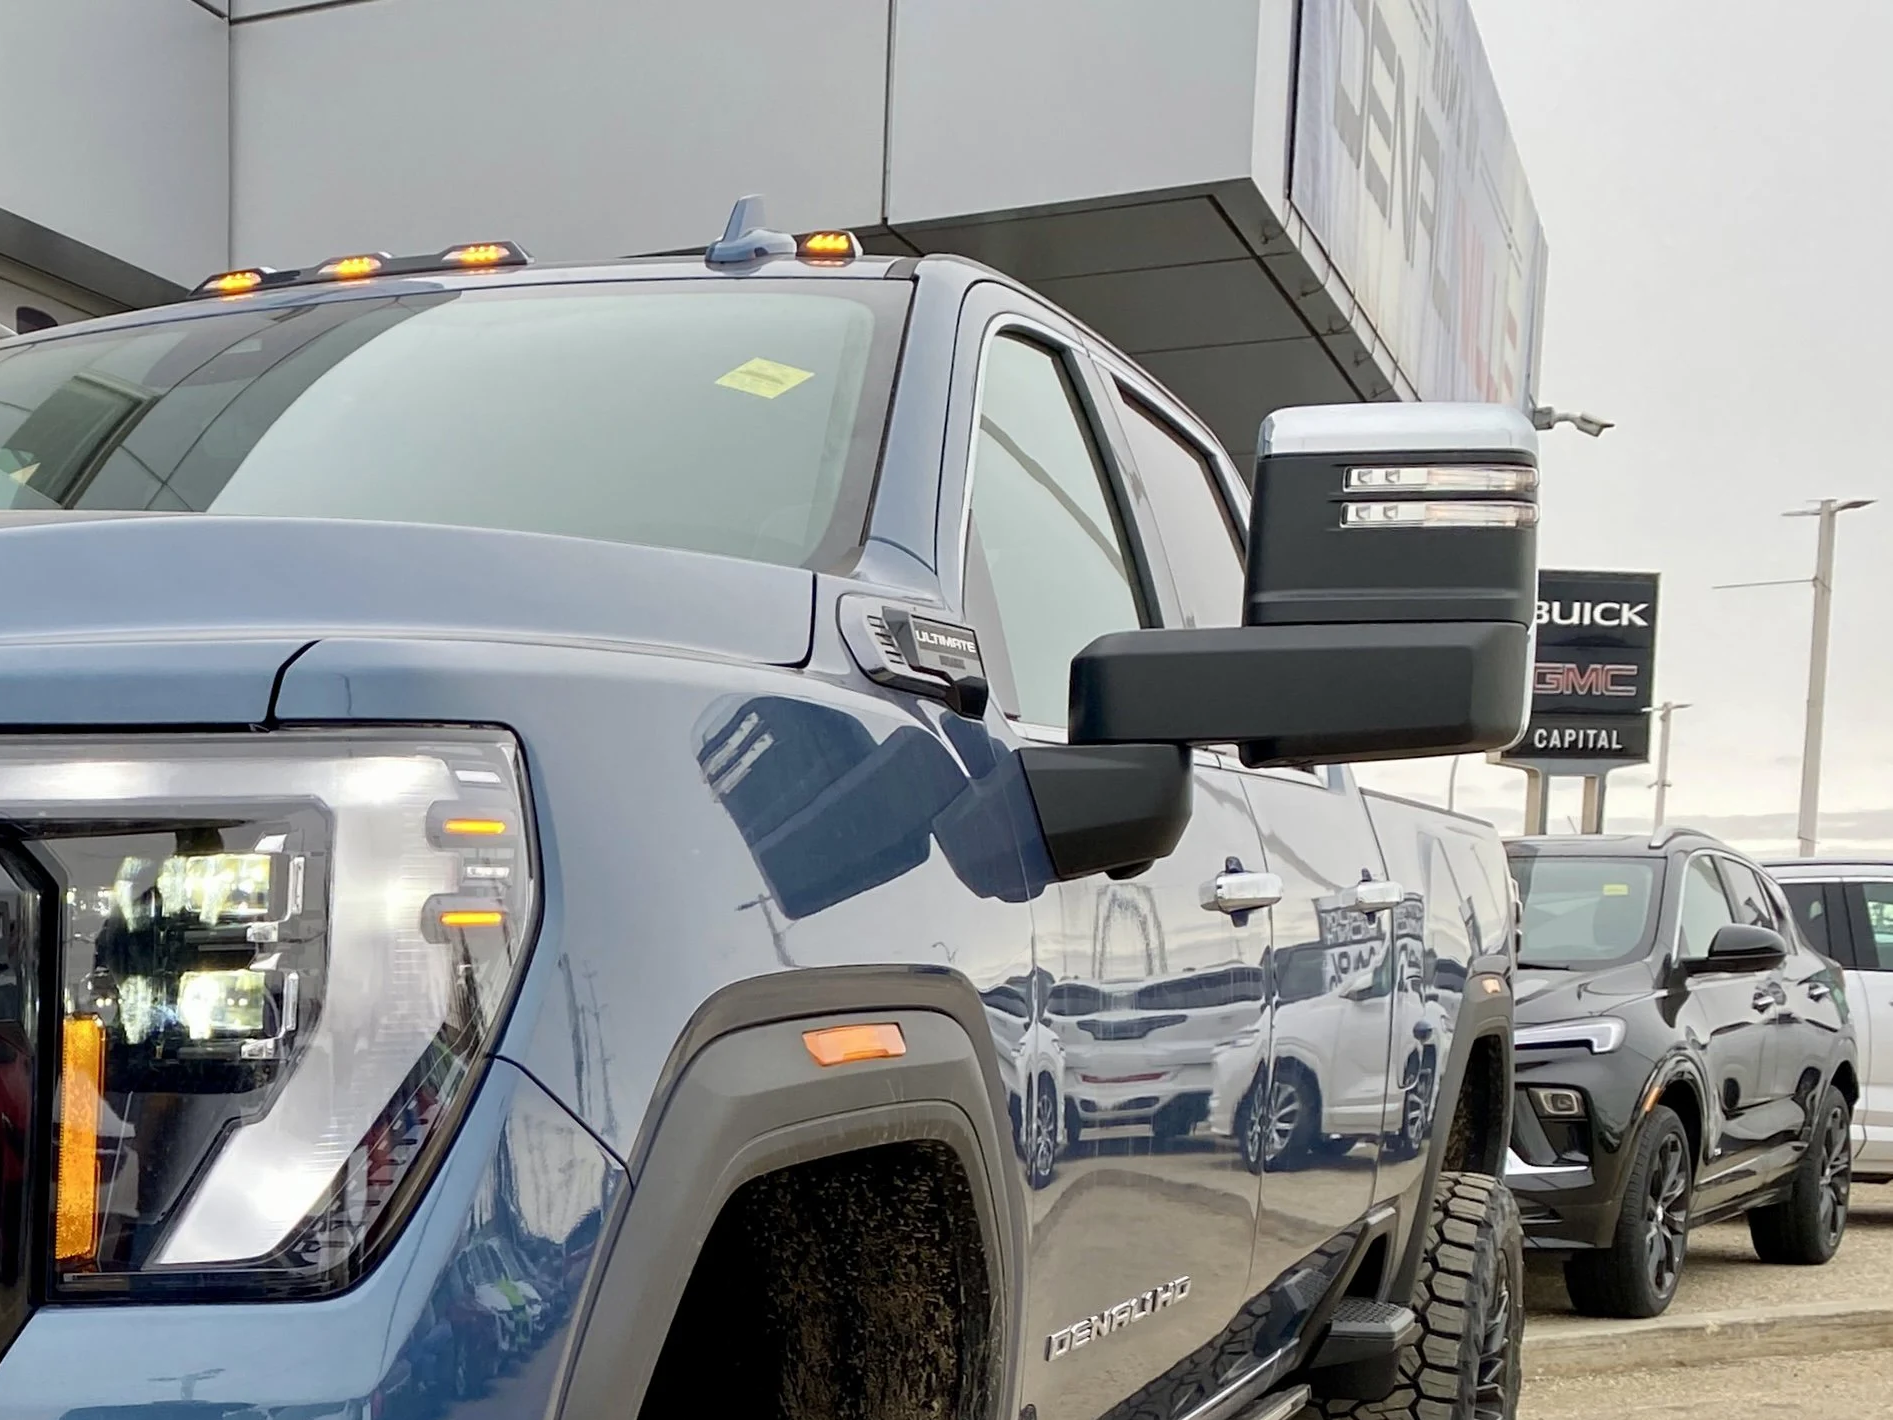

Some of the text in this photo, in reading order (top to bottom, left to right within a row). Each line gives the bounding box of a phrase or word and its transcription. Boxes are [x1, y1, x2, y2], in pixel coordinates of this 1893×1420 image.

[1536, 601, 1649, 627] BUICK
[915, 629, 976, 653] ULTIMATE
[1533, 662, 1638, 696] GMC
[1534, 728, 1623, 749] CAPITAL
[1044, 1290, 1154, 1362] DENALI
